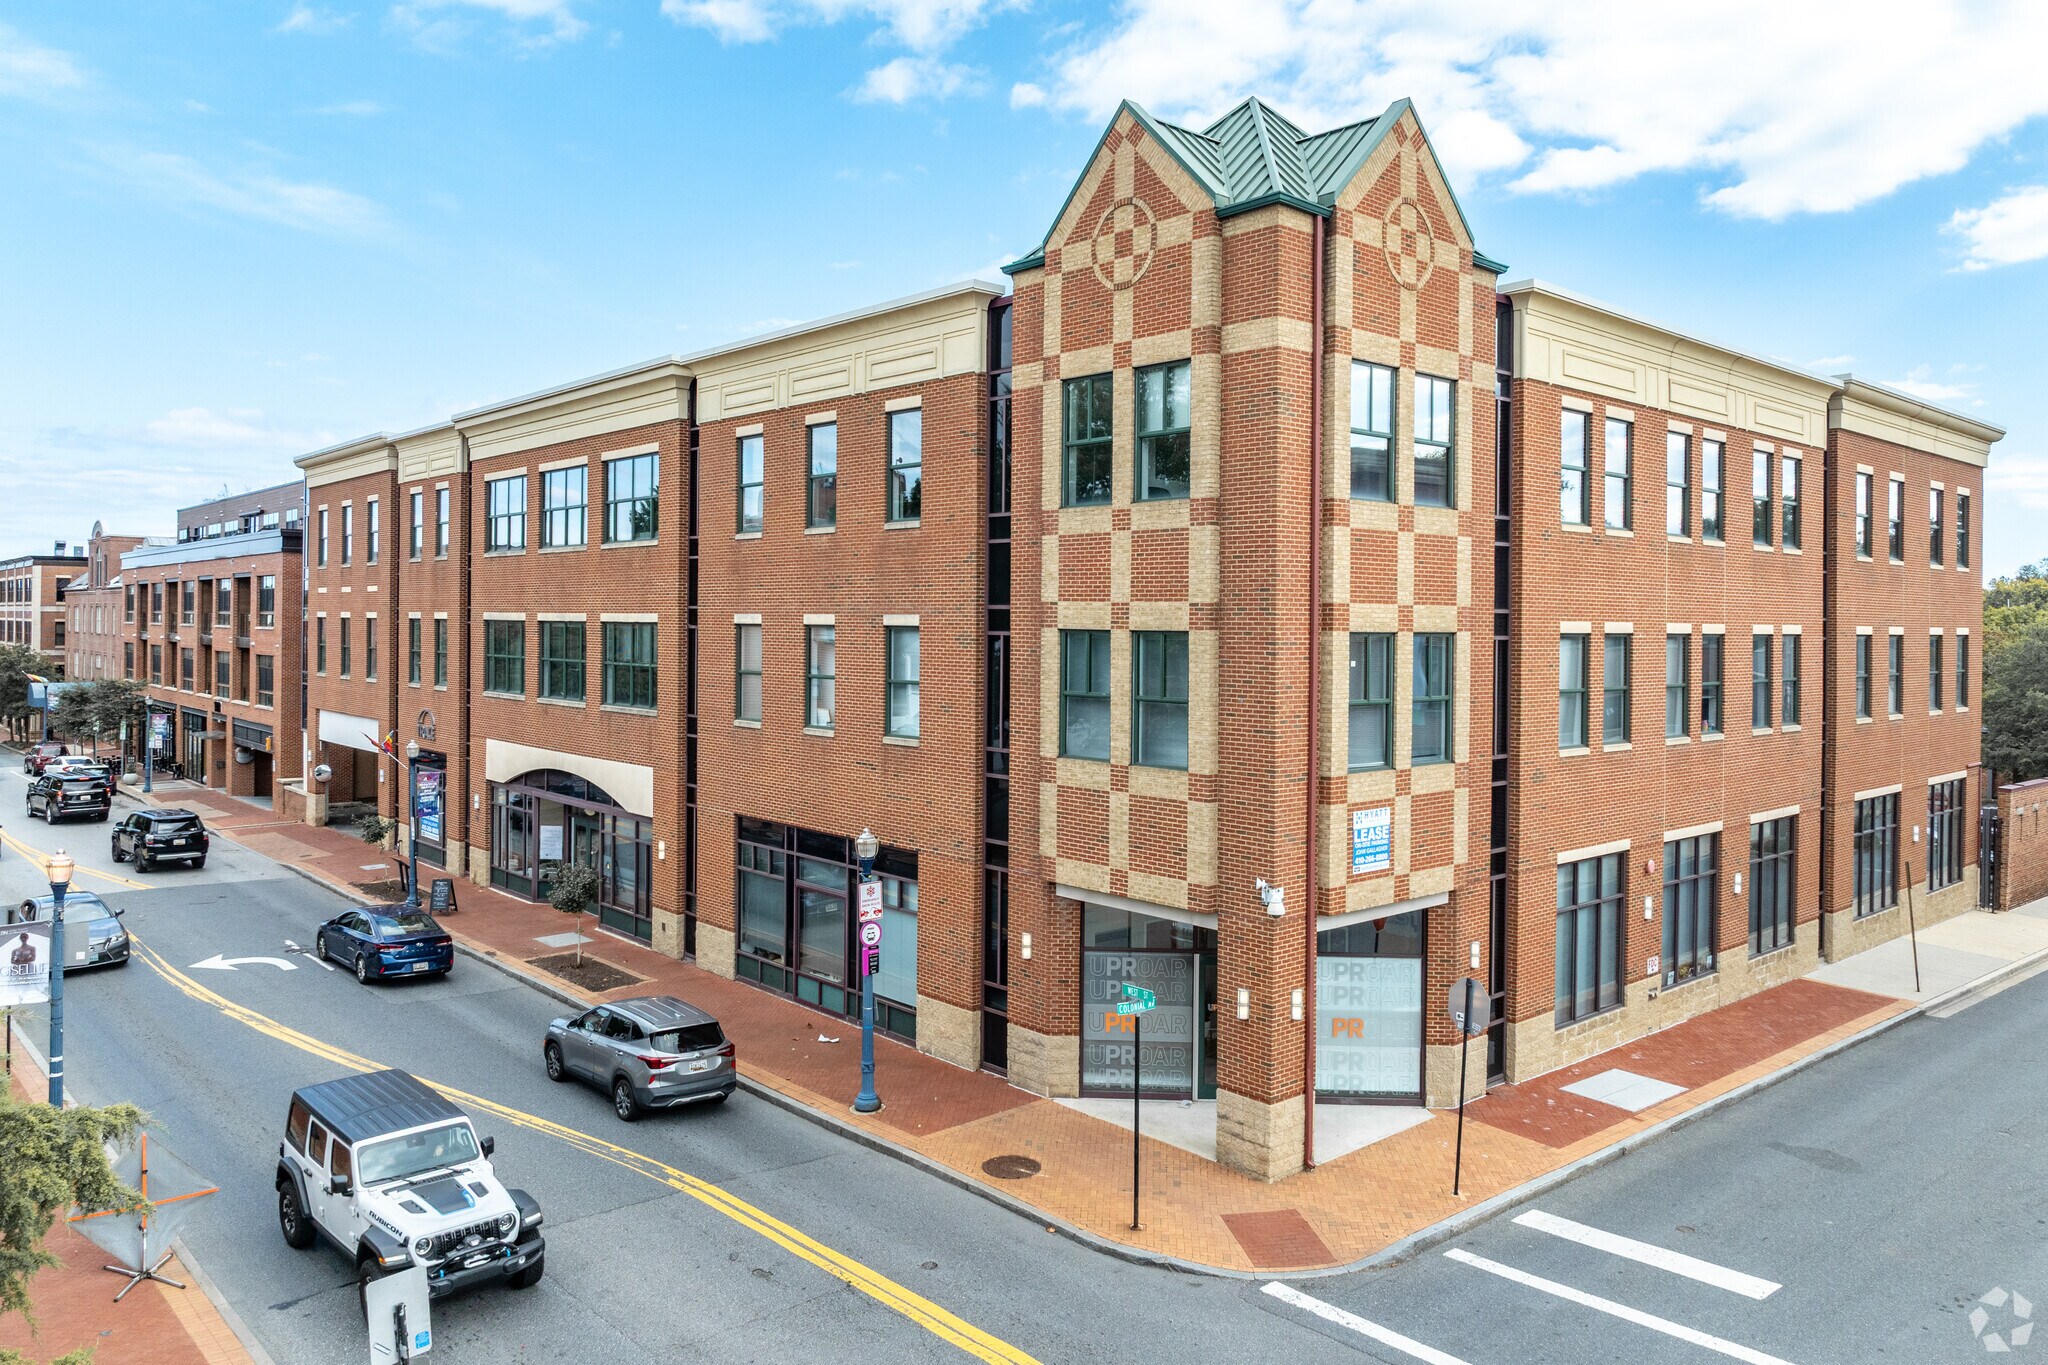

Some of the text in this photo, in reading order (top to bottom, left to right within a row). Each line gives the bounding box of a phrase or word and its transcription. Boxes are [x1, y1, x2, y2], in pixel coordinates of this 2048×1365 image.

[1364, 808, 1388, 819] HYATT
[1354, 825, 1389, 842] LEASE
[1089, 956, 1187, 978] UPROAR
[1317, 961, 1416, 983] UPROAR
[1127, 987, 1149, 1000] WEST ST
[1119, 1001, 1146, 1013] COLONIAL
[1088, 1011, 1187, 1034] UPROAR
[1088, 1044, 1186, 1067] UPROAR
[1088, 1068, 1186, 1090] UPROAR
[368, 1210, 403, 1237] RUBICON
